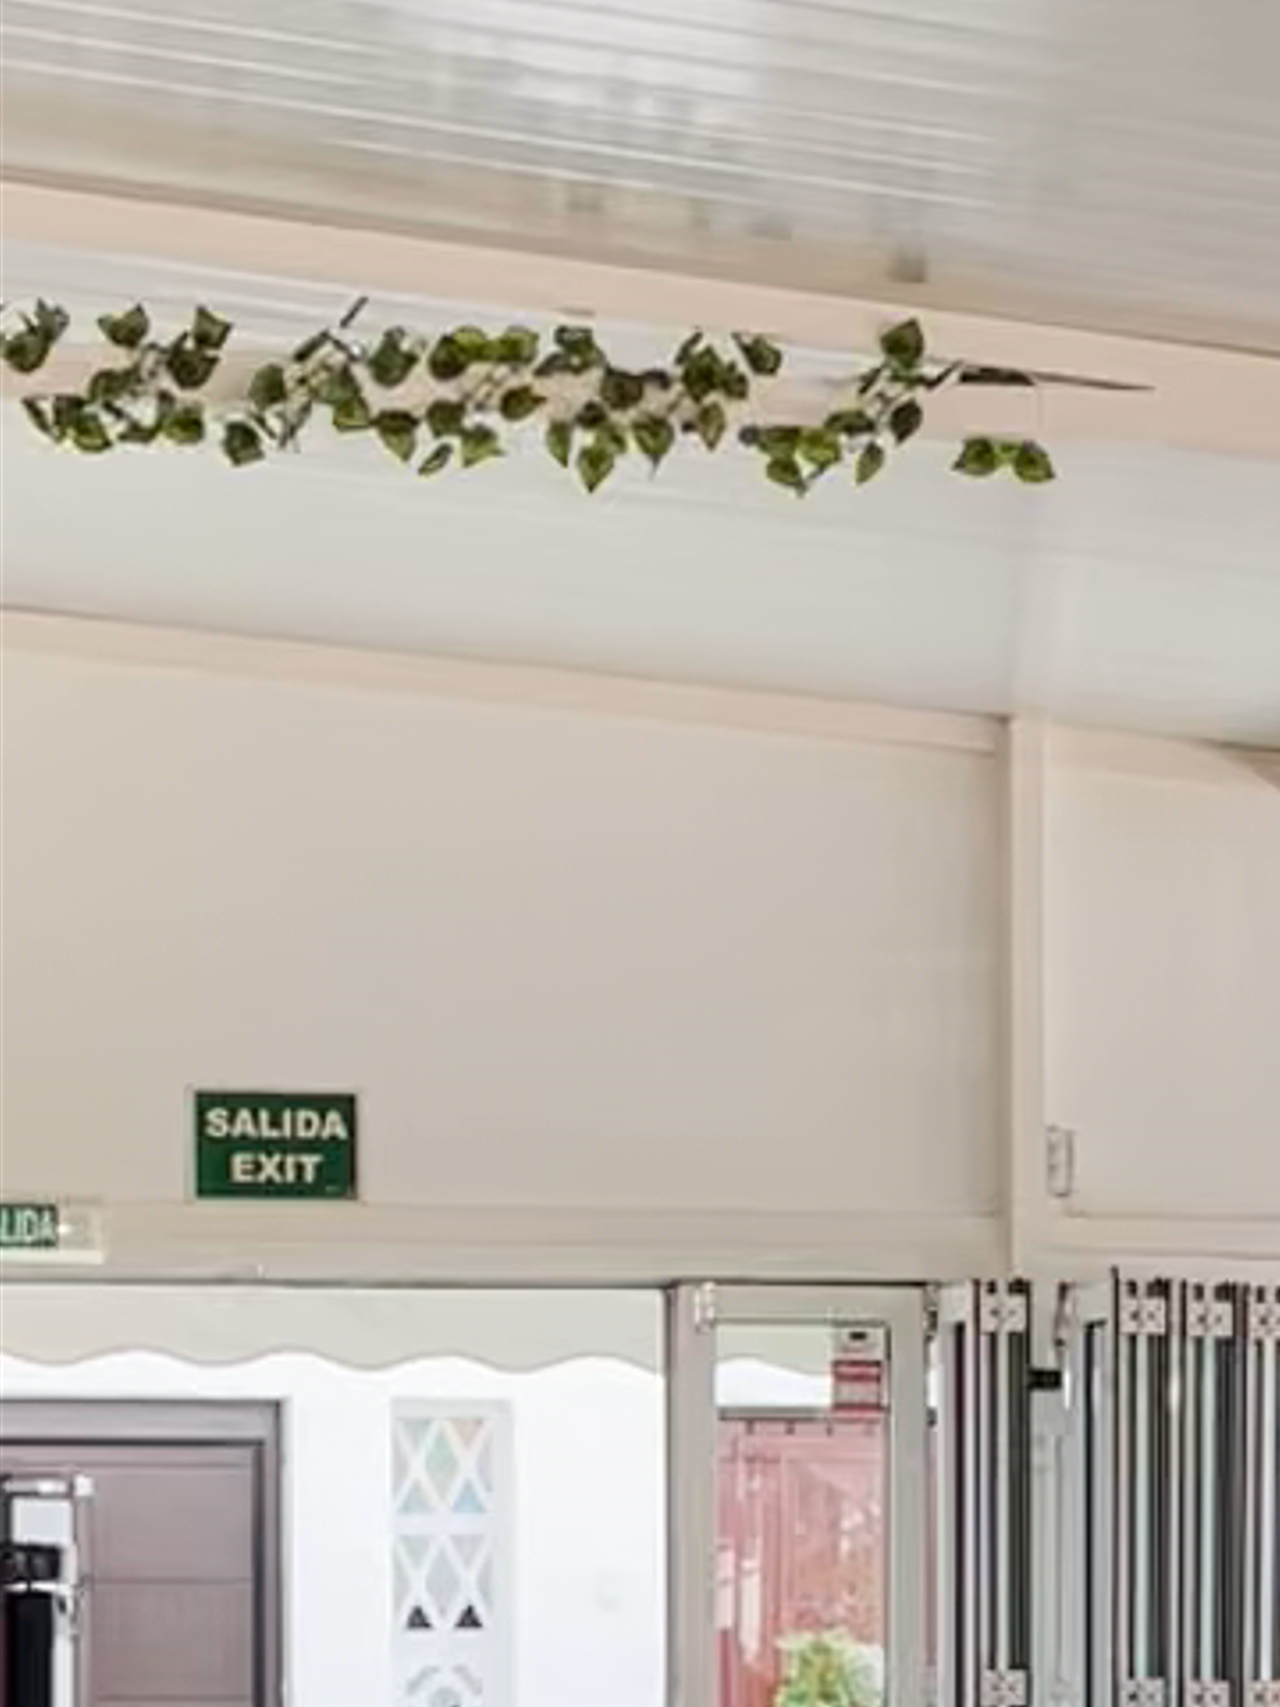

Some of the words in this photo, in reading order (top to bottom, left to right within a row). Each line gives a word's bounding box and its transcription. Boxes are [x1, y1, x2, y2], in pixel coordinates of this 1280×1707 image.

[204, 1107, 348, 1140] SALIDA
[230, 1152, 324, 1184] EXIT
[0, 1207, 56, 1244] LIDA
